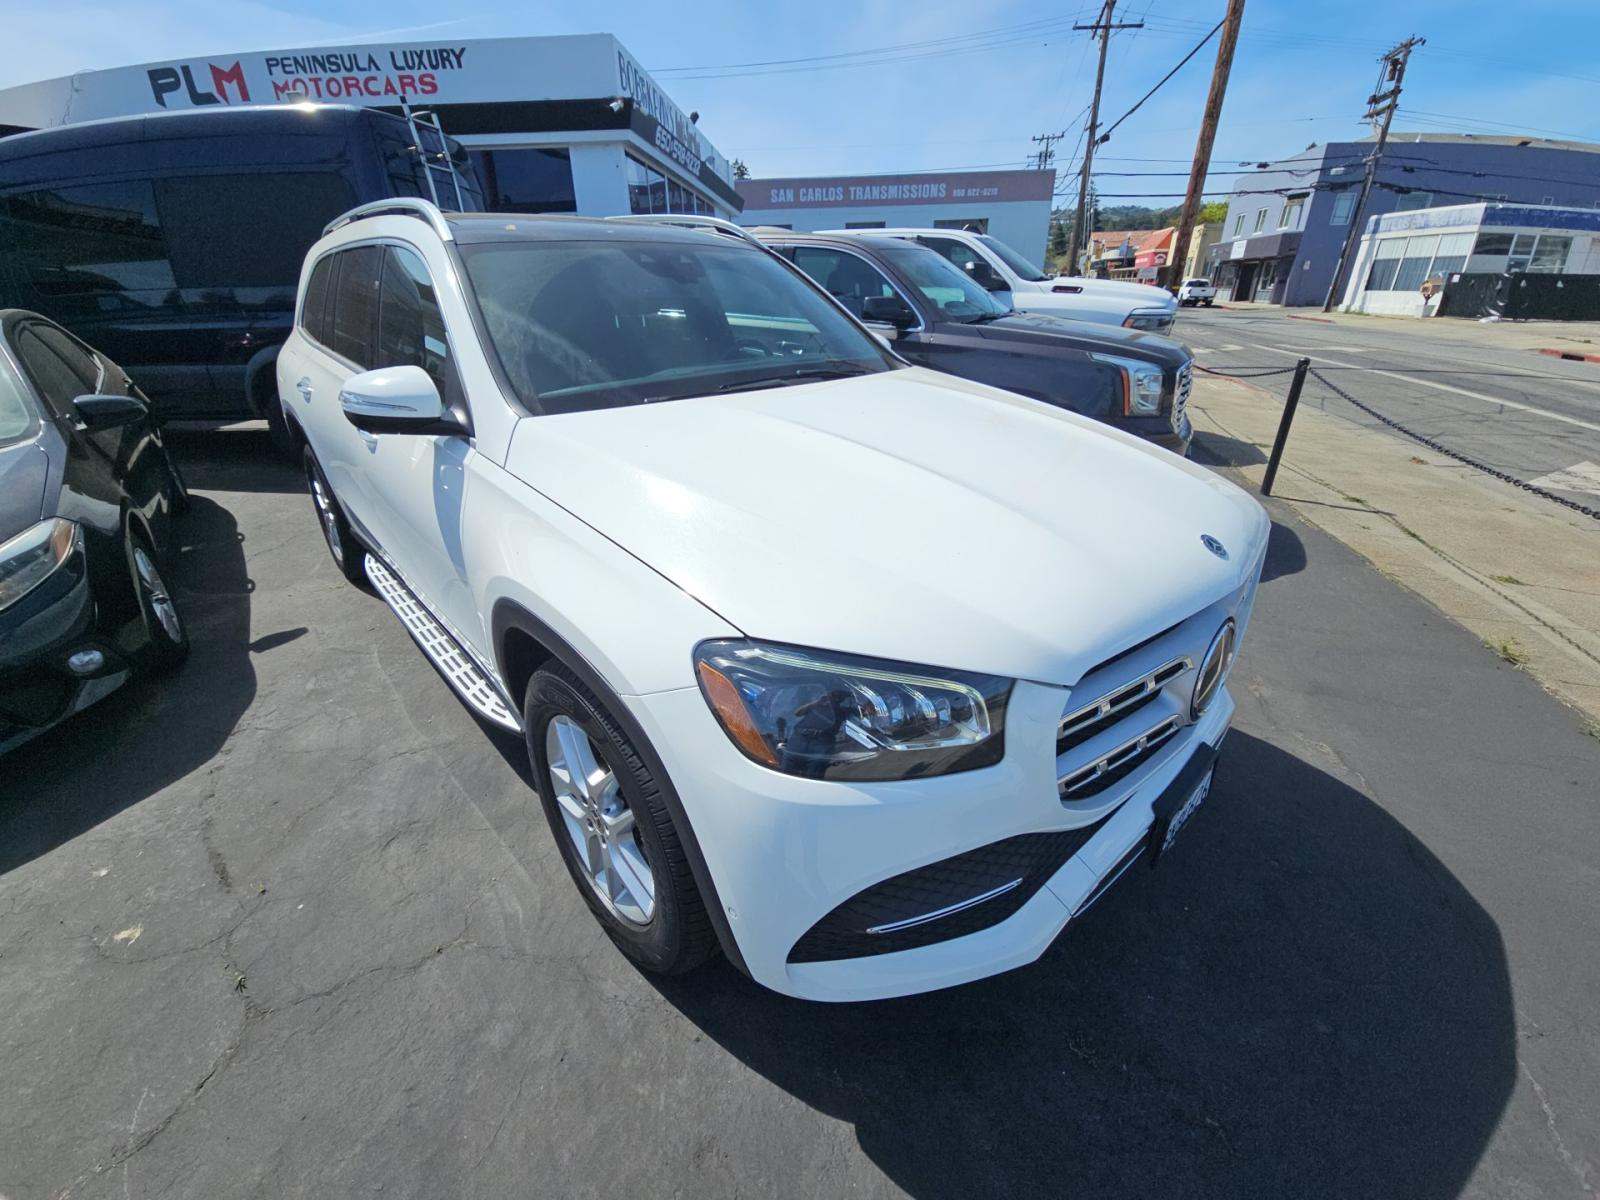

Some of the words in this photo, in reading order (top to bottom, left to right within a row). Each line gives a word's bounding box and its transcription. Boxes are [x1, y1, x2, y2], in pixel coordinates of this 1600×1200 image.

[265, 52, 381, 75] PENINSULA
[389, 47, 466, 71] LUXURY
[147, 60, 251, 109] PLM
[272, 73, 438, 100] MOTORCARS
[770, 188, 794, 203] SAN
[800, 186, 844, 202] CARLOS
[848, 183, 946, 200] TRANSMISSIONS
